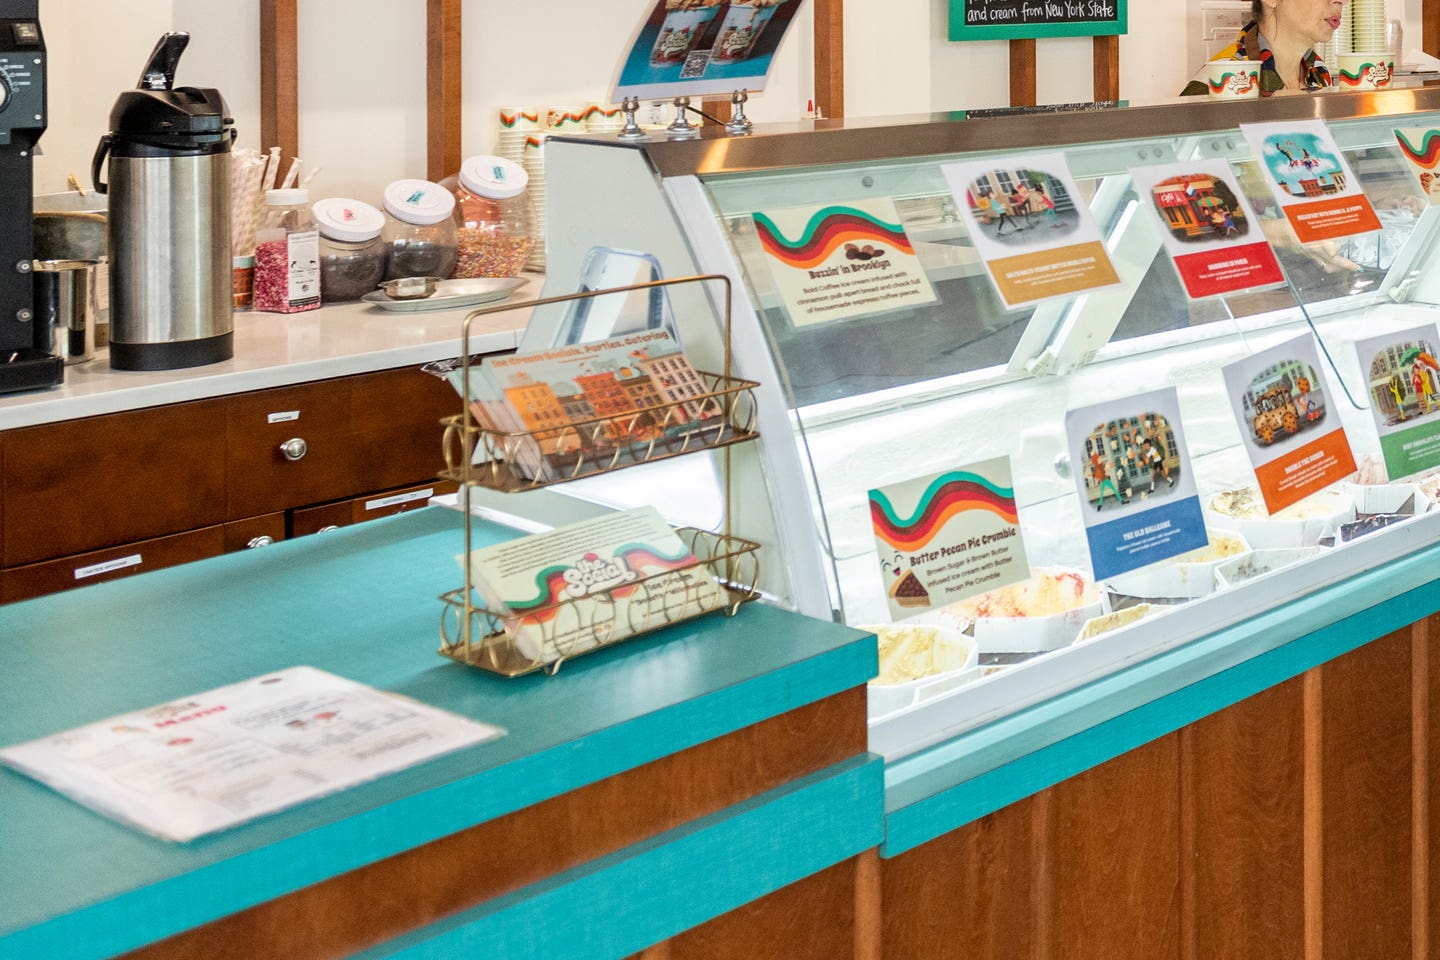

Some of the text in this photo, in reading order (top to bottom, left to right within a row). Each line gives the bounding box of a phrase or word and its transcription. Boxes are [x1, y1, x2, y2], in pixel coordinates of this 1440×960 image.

[967, 1, 1114, 22] and cream from New York State
[808, 259, 891, 280] Buzzin' in Brooklyn
[909, 527, 1017, 567] Butter Pecan Pie Crumble
